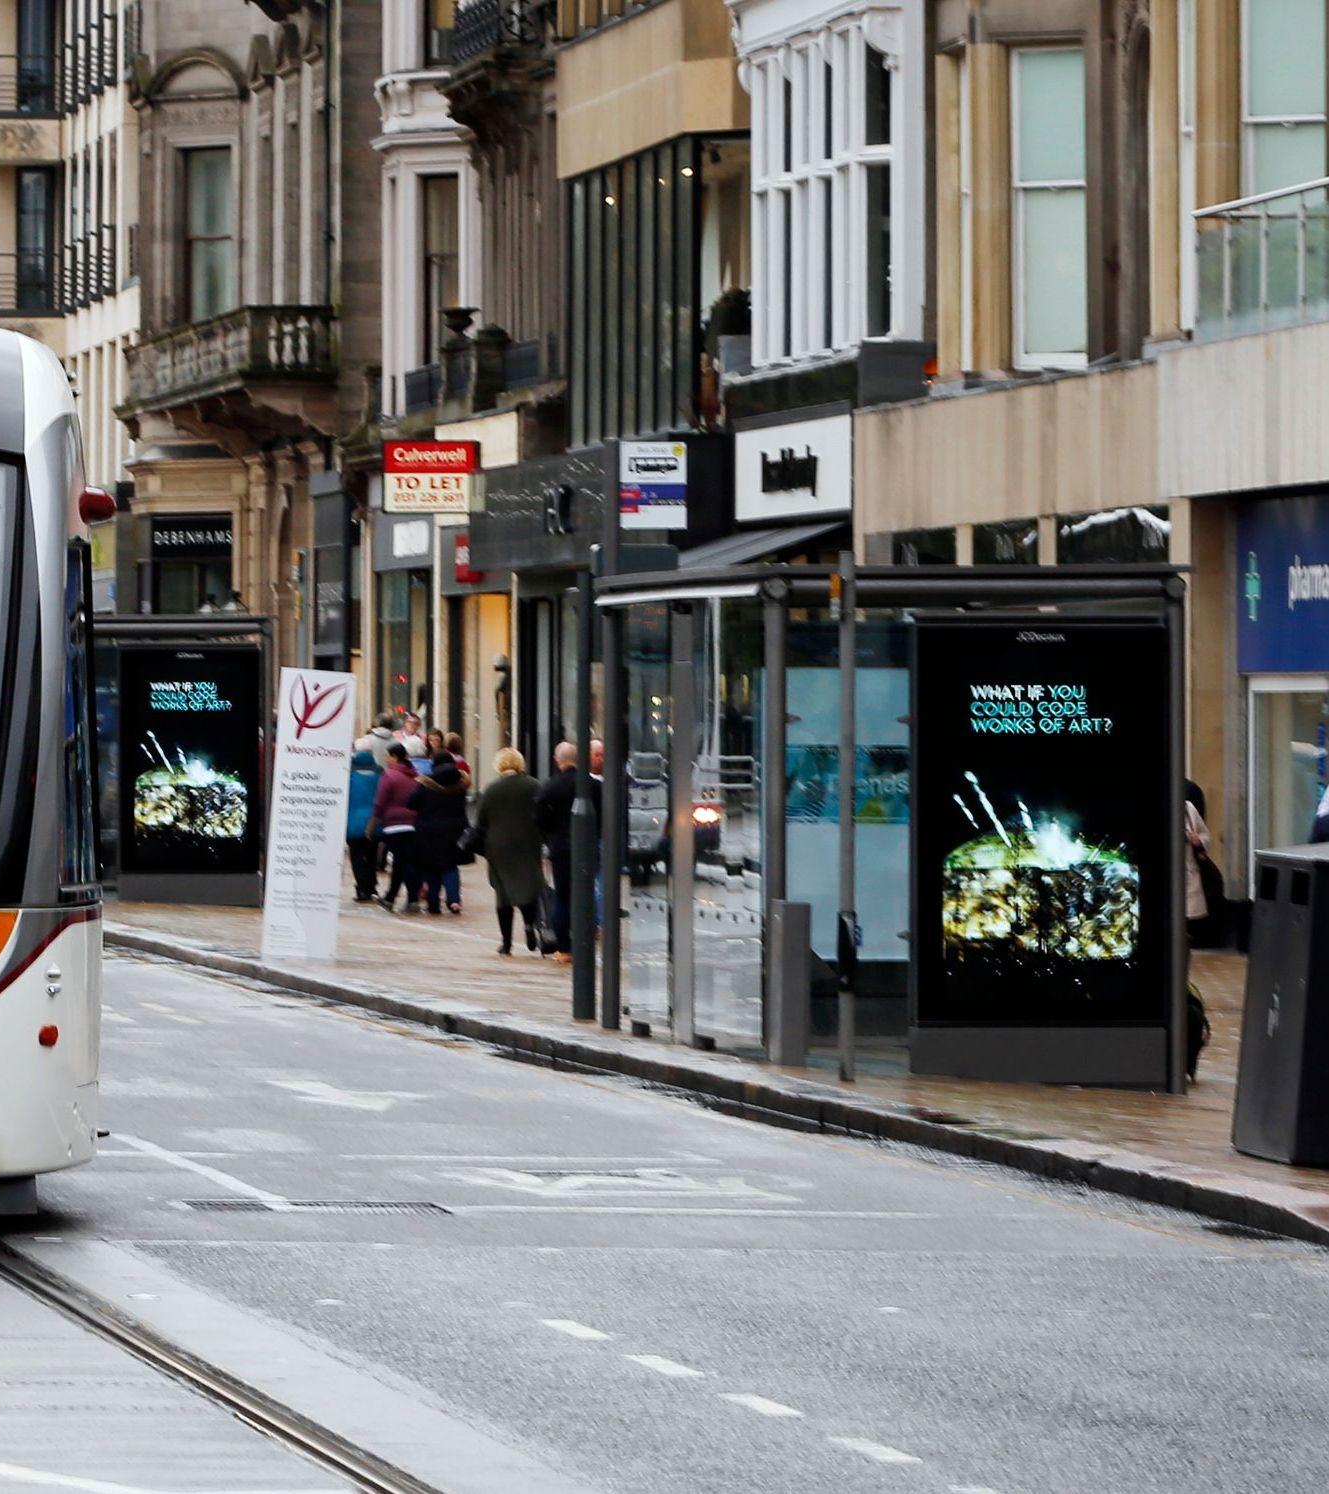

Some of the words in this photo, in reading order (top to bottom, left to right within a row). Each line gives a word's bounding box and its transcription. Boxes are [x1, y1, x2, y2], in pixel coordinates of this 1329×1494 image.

[393, 447, 468, 464] Culverwell
[394, 476, 421, 490] TO
[429, 476, 465, 490] LET
[153, 529, 233, 546] DEBENHAMS
[970, 684, 1024, 701] WHAT
[1027, 684, 1045, 701] IF
[1048, 684, 1087, 700] YOU
[971, 701, 1034, 717] COULD
[1037, 701, 1088, 717] CODE
[971, 718, 1036, 734] WORKS
[1039, 718, 1065, 734] OF
[1068, 718, 1113, 734] ART?
